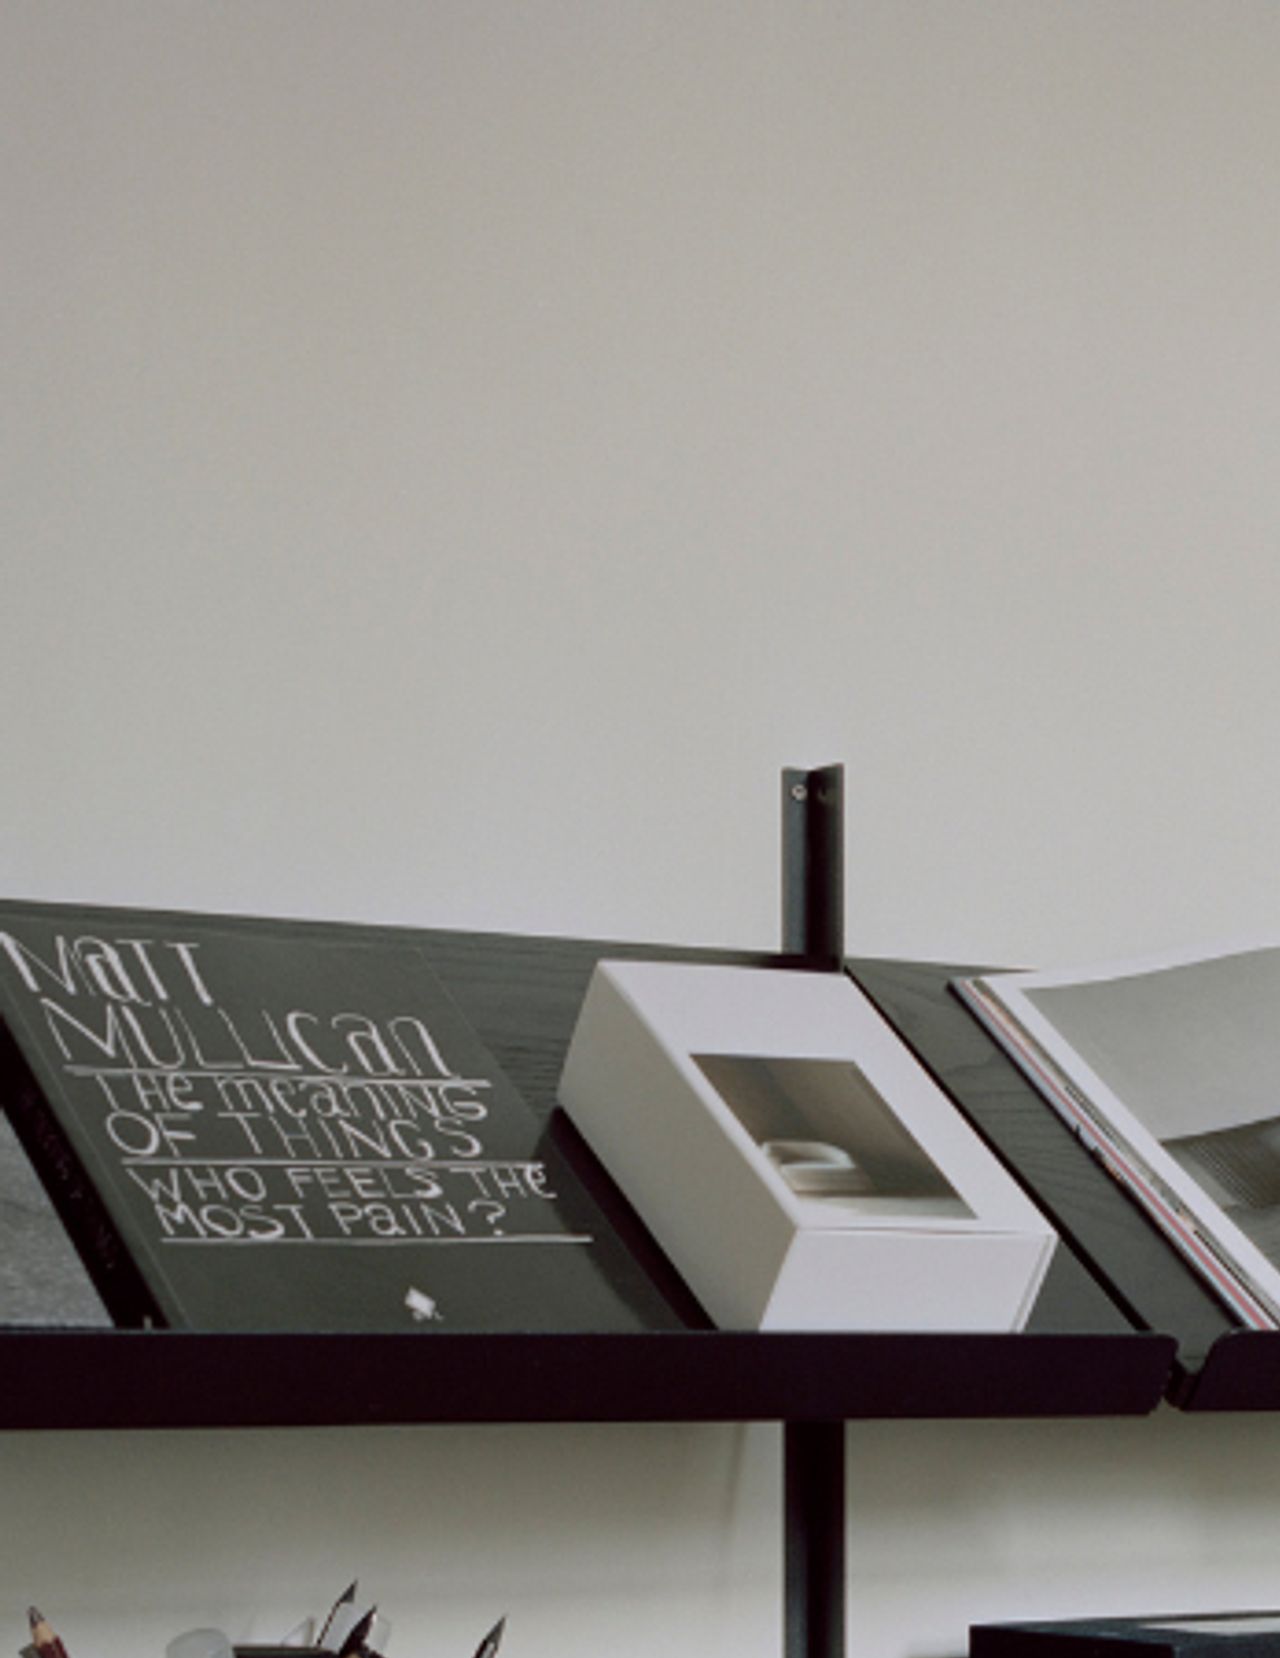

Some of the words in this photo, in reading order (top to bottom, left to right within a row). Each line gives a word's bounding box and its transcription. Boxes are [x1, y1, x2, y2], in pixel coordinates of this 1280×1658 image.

[105, 1110, 196, 1158] OF
[217, 1113, 482, 1160] THINGS
[126, 1168, 267, 1203] WHO
[285, 1167, 443, 1199] FEELS
[155, 1203, 314, 1240] MOST
